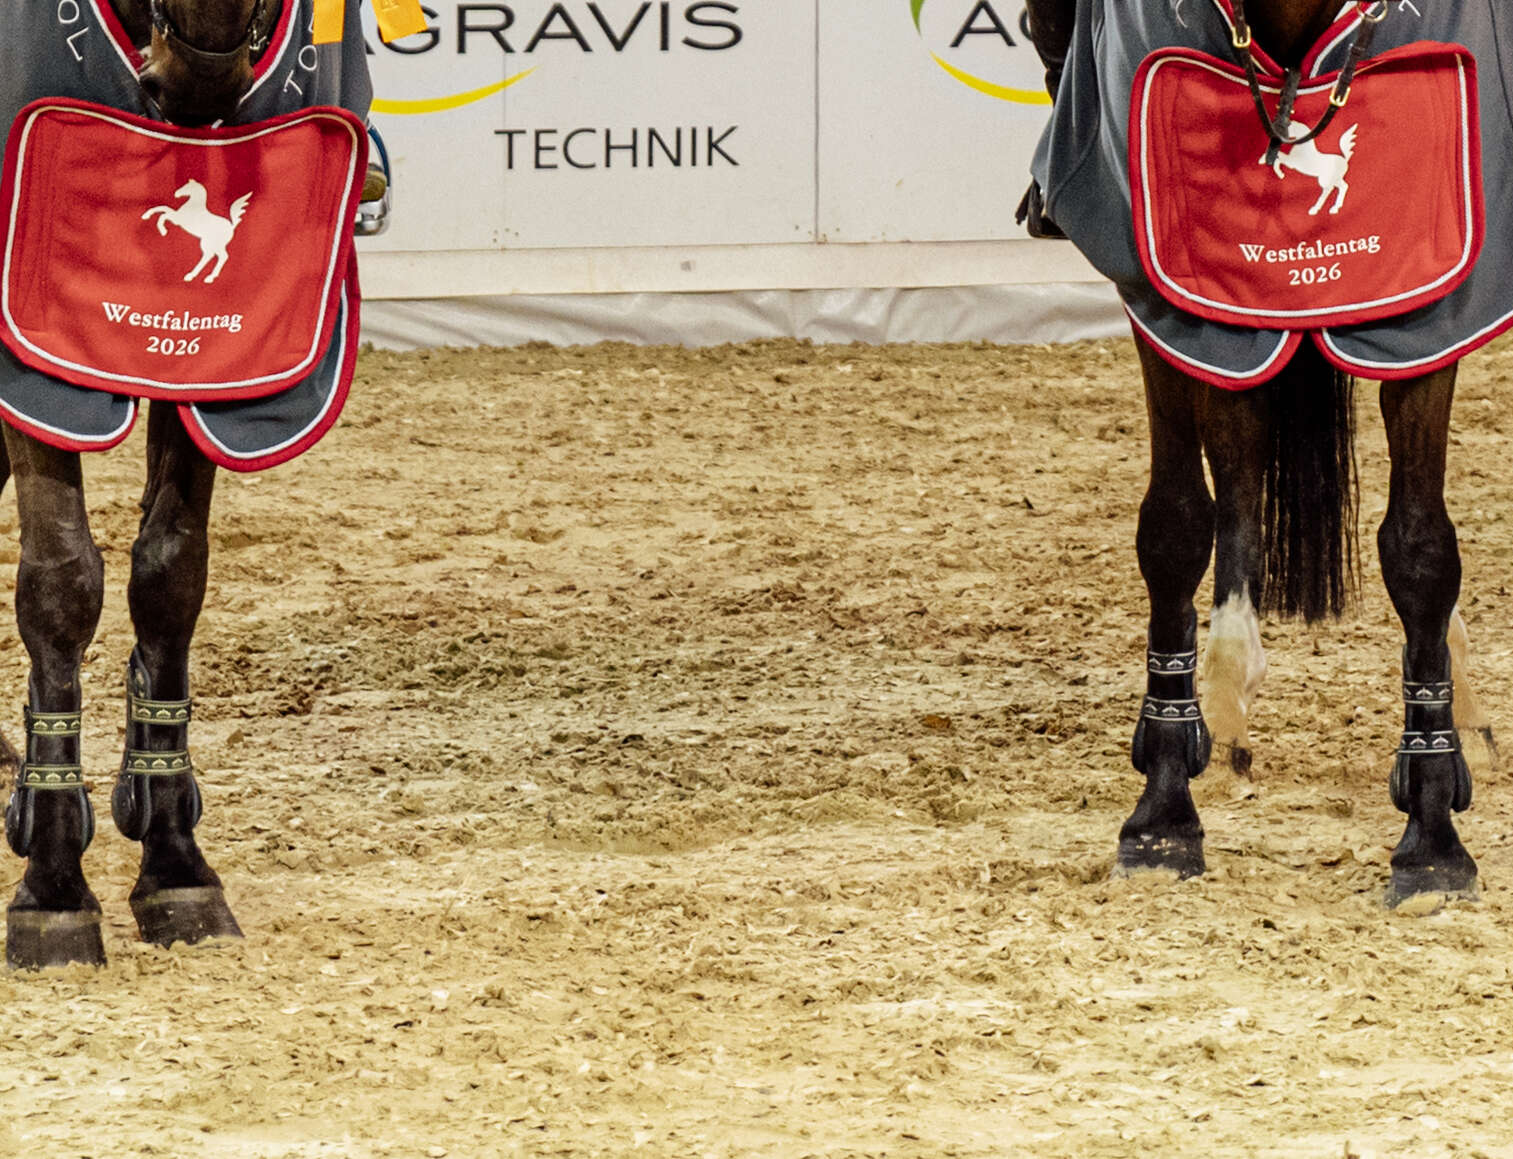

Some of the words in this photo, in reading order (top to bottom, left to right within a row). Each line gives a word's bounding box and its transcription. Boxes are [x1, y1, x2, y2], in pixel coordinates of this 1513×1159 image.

[366, 0, 744, 55] GRAVIS
[494, 125, 739, 170] TECHNIK
[1239, 235, 1381, 263] Westfalentag
[1289, 262, 1342, 286] 2026
[102, 301, 244, 333] Westfalentag
[146, 335, 201, 356] 2026
